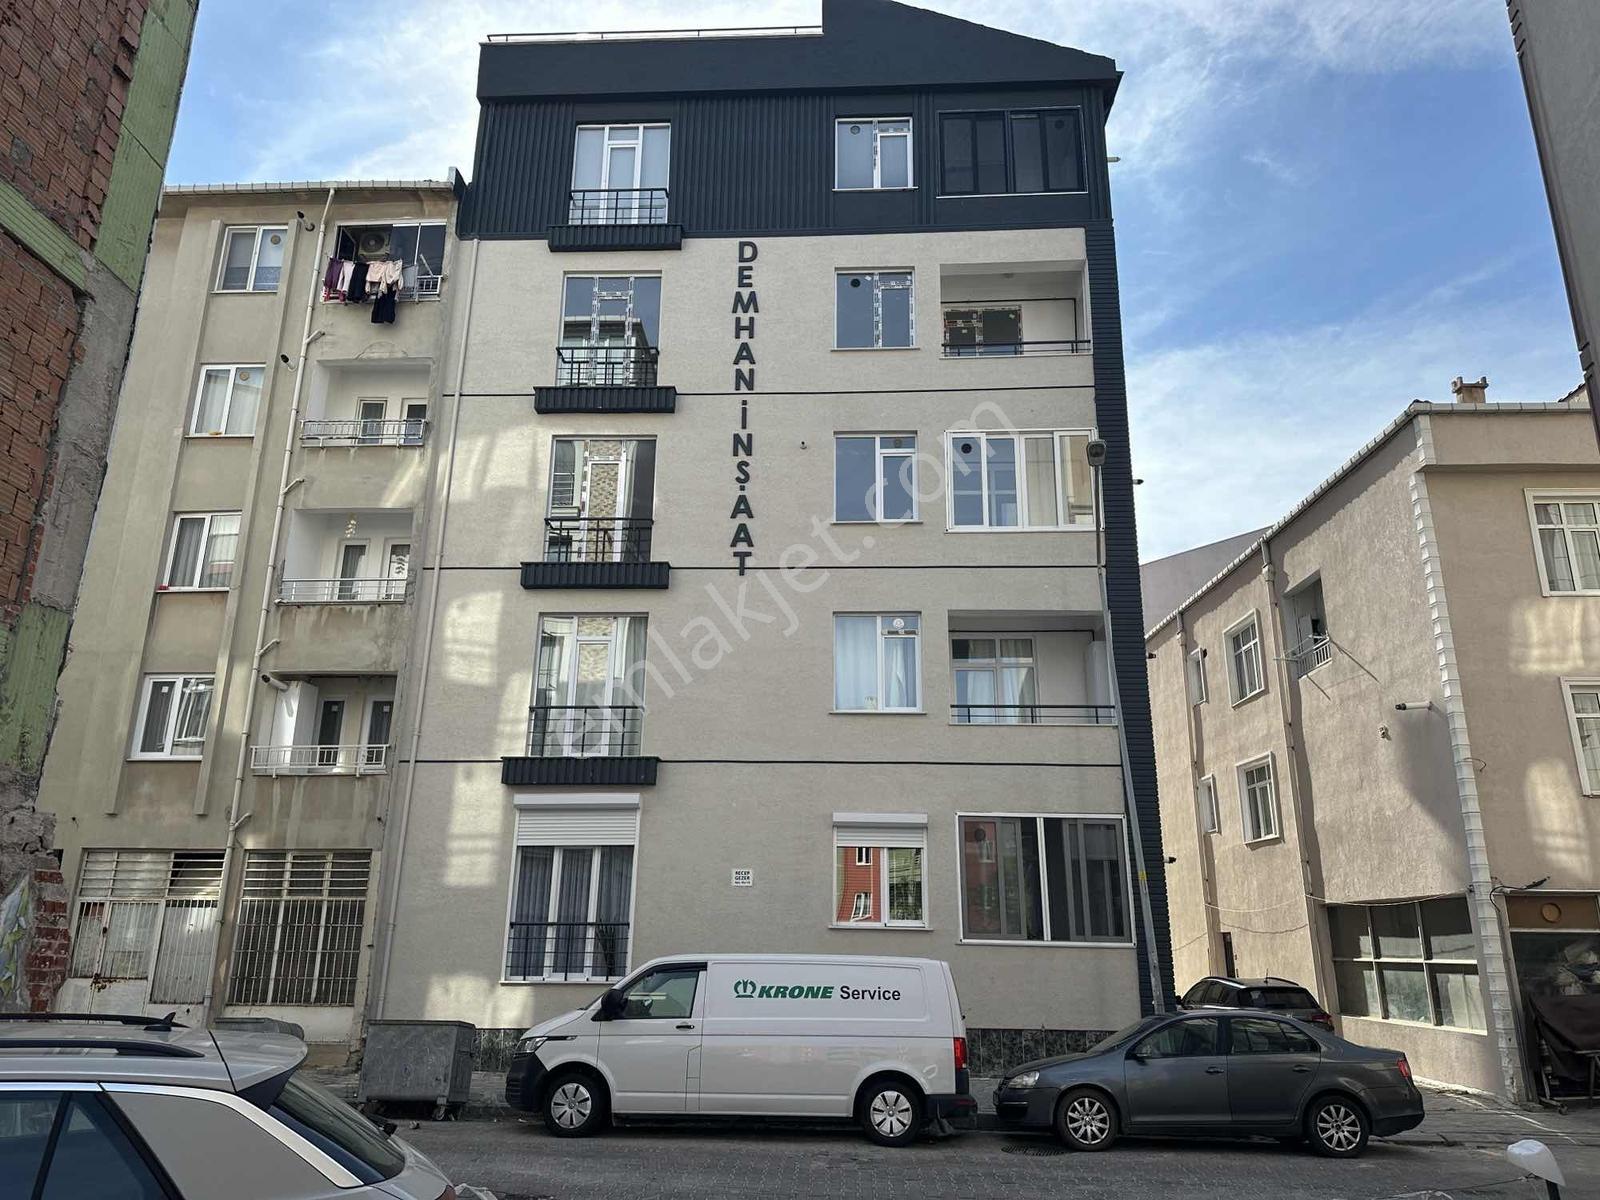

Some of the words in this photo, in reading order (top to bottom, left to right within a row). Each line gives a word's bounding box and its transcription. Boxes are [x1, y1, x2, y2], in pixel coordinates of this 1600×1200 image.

[731, 241, 759, 391] DEMHAN
[730, 400, 754, 576] İNŞAAT
[758, 985, 834, 999] KRONE
[840, 985, 901, 1001] Service
